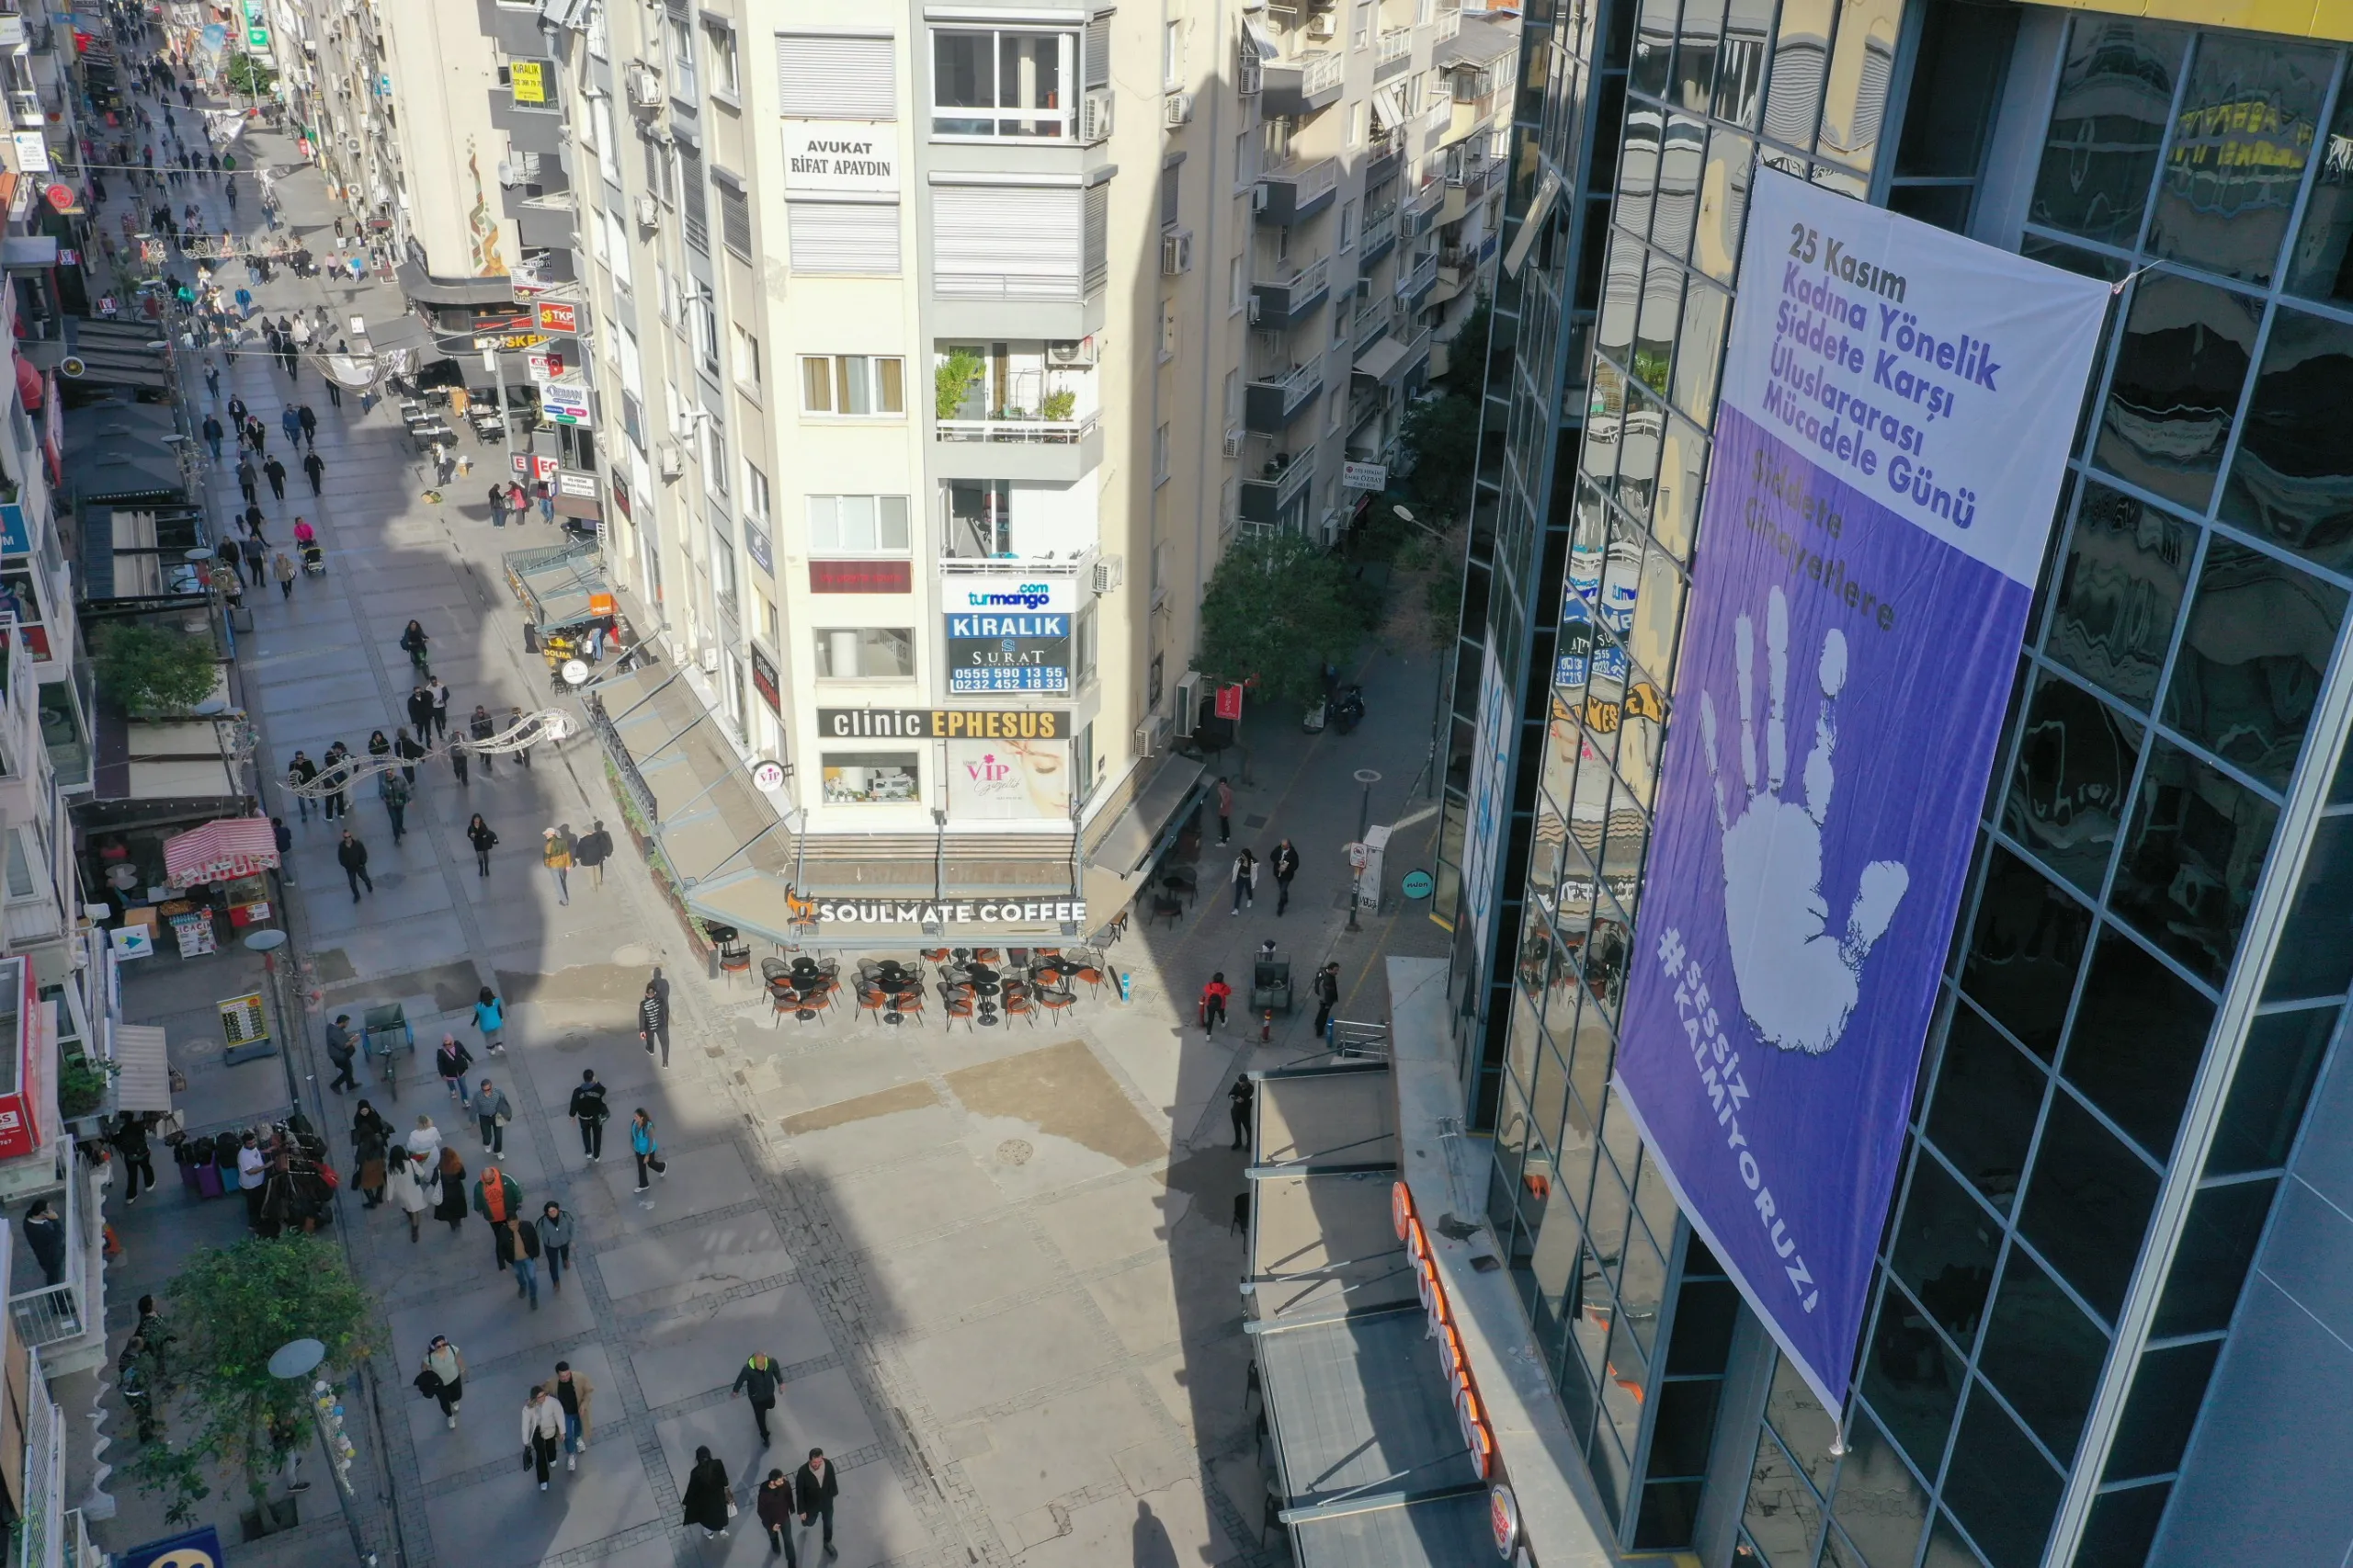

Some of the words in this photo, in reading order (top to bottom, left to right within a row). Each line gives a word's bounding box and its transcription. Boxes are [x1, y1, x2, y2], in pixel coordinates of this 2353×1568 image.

[807, 140, 872, 154] AVUKAT
[790, 154, 829, 173] RİFAT
[834, 160, 891, 176] APAYDIN
[1788, 222, 1818, 264] 25
[1824, 237, 1907, 303] Kasım
[552, 311, 574, 322] TKP
[1782, 261, 1868, 332] Kadına
[1879, 303, 2002, 392] Yönelik
[1776, 300, 1865, 374] Şiddete
[1873, 349, 1956, 423] Karşı
[1769, 341, 1925, 457] Uluslararası
[1762, 380, 1878, 476] Mücadele
[1888, 455, 1976, 530] Günü
[968, 592, 1050, 609] turmango
[953, 615, 1062, 637] KİRALIK
[972, 650, 1045, 665] SURAT
[956, 669, 989, 679] 0555
[994, 668, 1019, 678] 590
[1026, 668, 1040, 677] 13
[1046, 667, 1063, 676] 55
[956, 680, 989, 689] 0232
[995, 679, 1019, 689] 452
[1026, 679, 1040, 688] 18
[1046, 678, 1063, 687] 33
[834, 710, 921, 736] clinic
[931, 711, 1055, 738] EPHESUS
[820, 903, 972, 923] SOULMATE
[980, 902, 1086, 922] COFFEE
[1673, 981, 1820, 1314] KALMIYORUZ!
